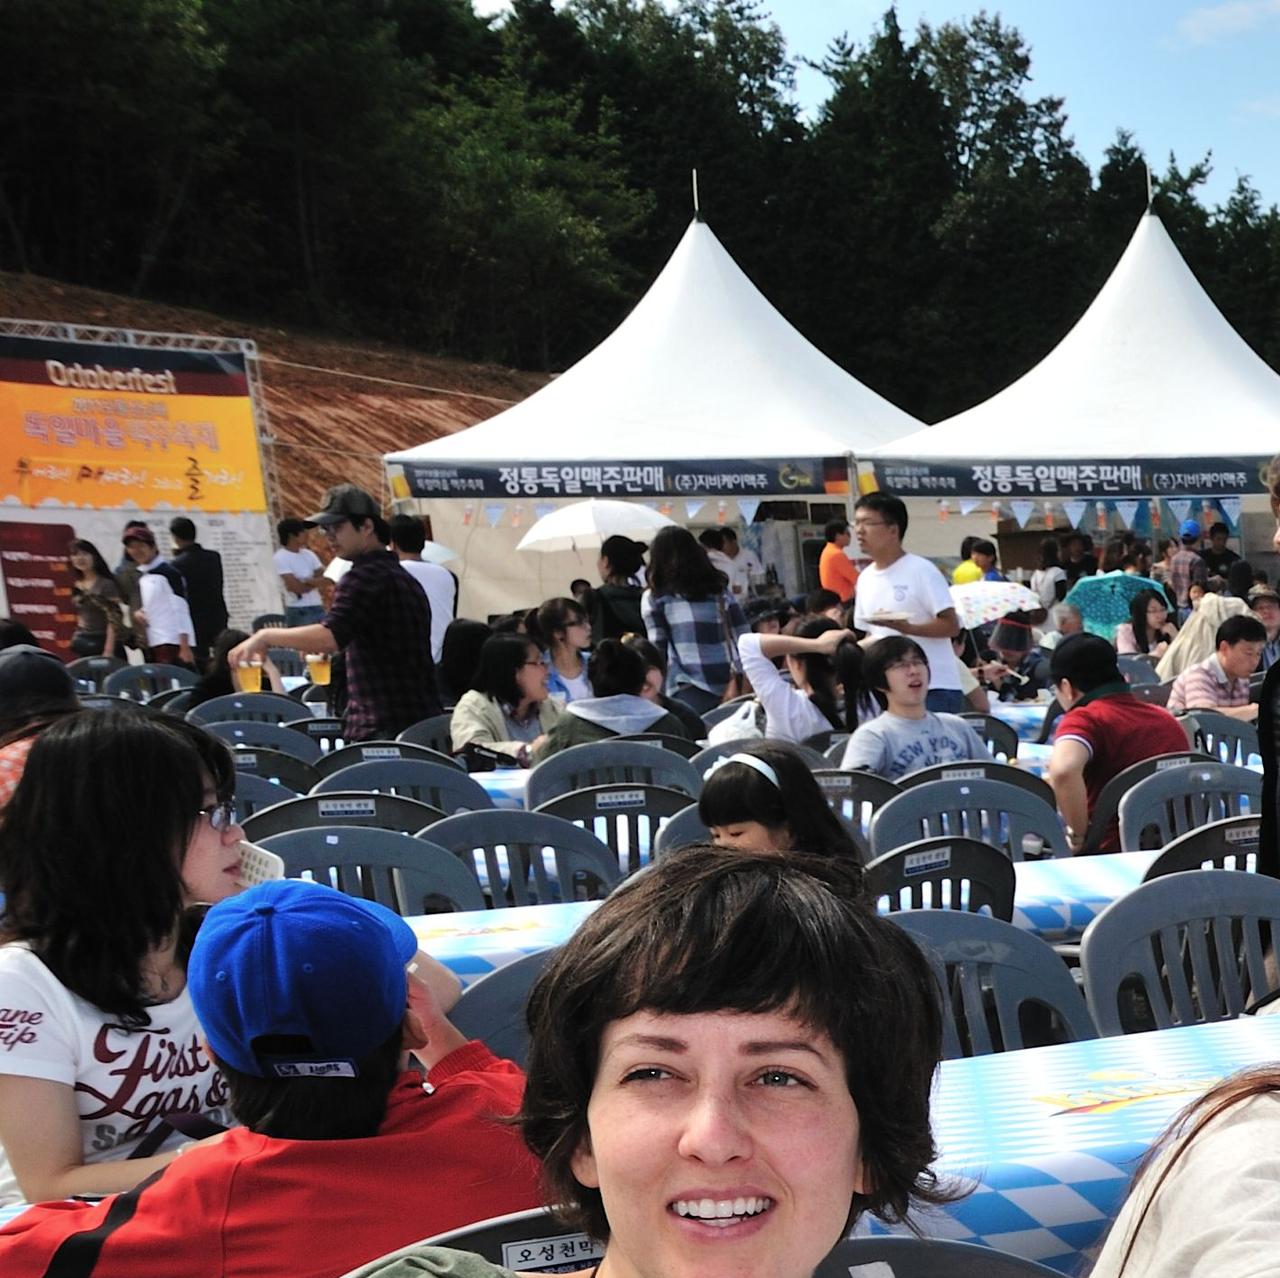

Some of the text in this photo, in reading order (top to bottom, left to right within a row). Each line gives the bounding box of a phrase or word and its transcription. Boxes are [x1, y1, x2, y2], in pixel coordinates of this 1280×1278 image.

[499, 466, 664, 494] 정통독일맥주판매
[674, 473, 768, 491] (주)지비케이맥주
[971, 464, 1142, 493] 정통독일맥주판매
[1152, 472, 1247, 490] (주)지비케이맥주
[890, 741, 924, 775] NEW
[517, 1240, 595, 1263] 오성천막
